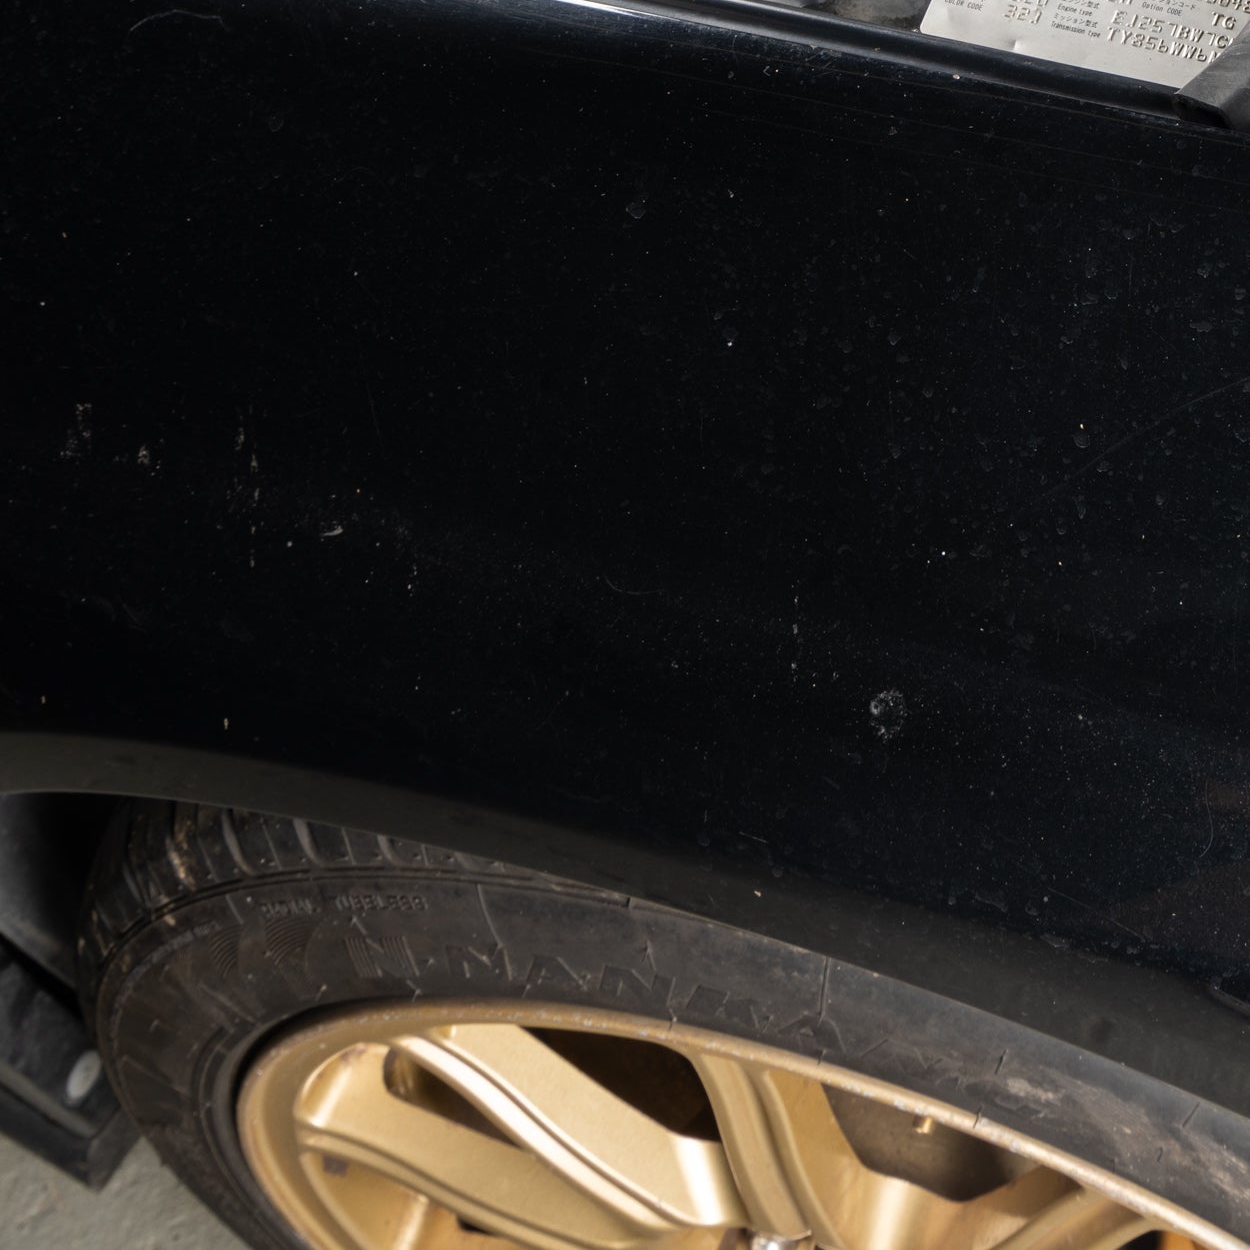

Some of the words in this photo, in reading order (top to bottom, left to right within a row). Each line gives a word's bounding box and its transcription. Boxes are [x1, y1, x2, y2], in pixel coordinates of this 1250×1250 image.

[967, 2, 983, 12] CODE
[1057, 3, 1078, 15] Engine
[1080, 8, 1093, 18] type
[1142, 2, 1163, 12] Option
[1166, 7, 1182, 17] CODE
[1051, 20, 1086, 35] Transmission
[1087, 27, 1101, 39] type
[1110, 9, 1234, 49] EJ257BW7C
[1211, 11, 1237, 31] TG
